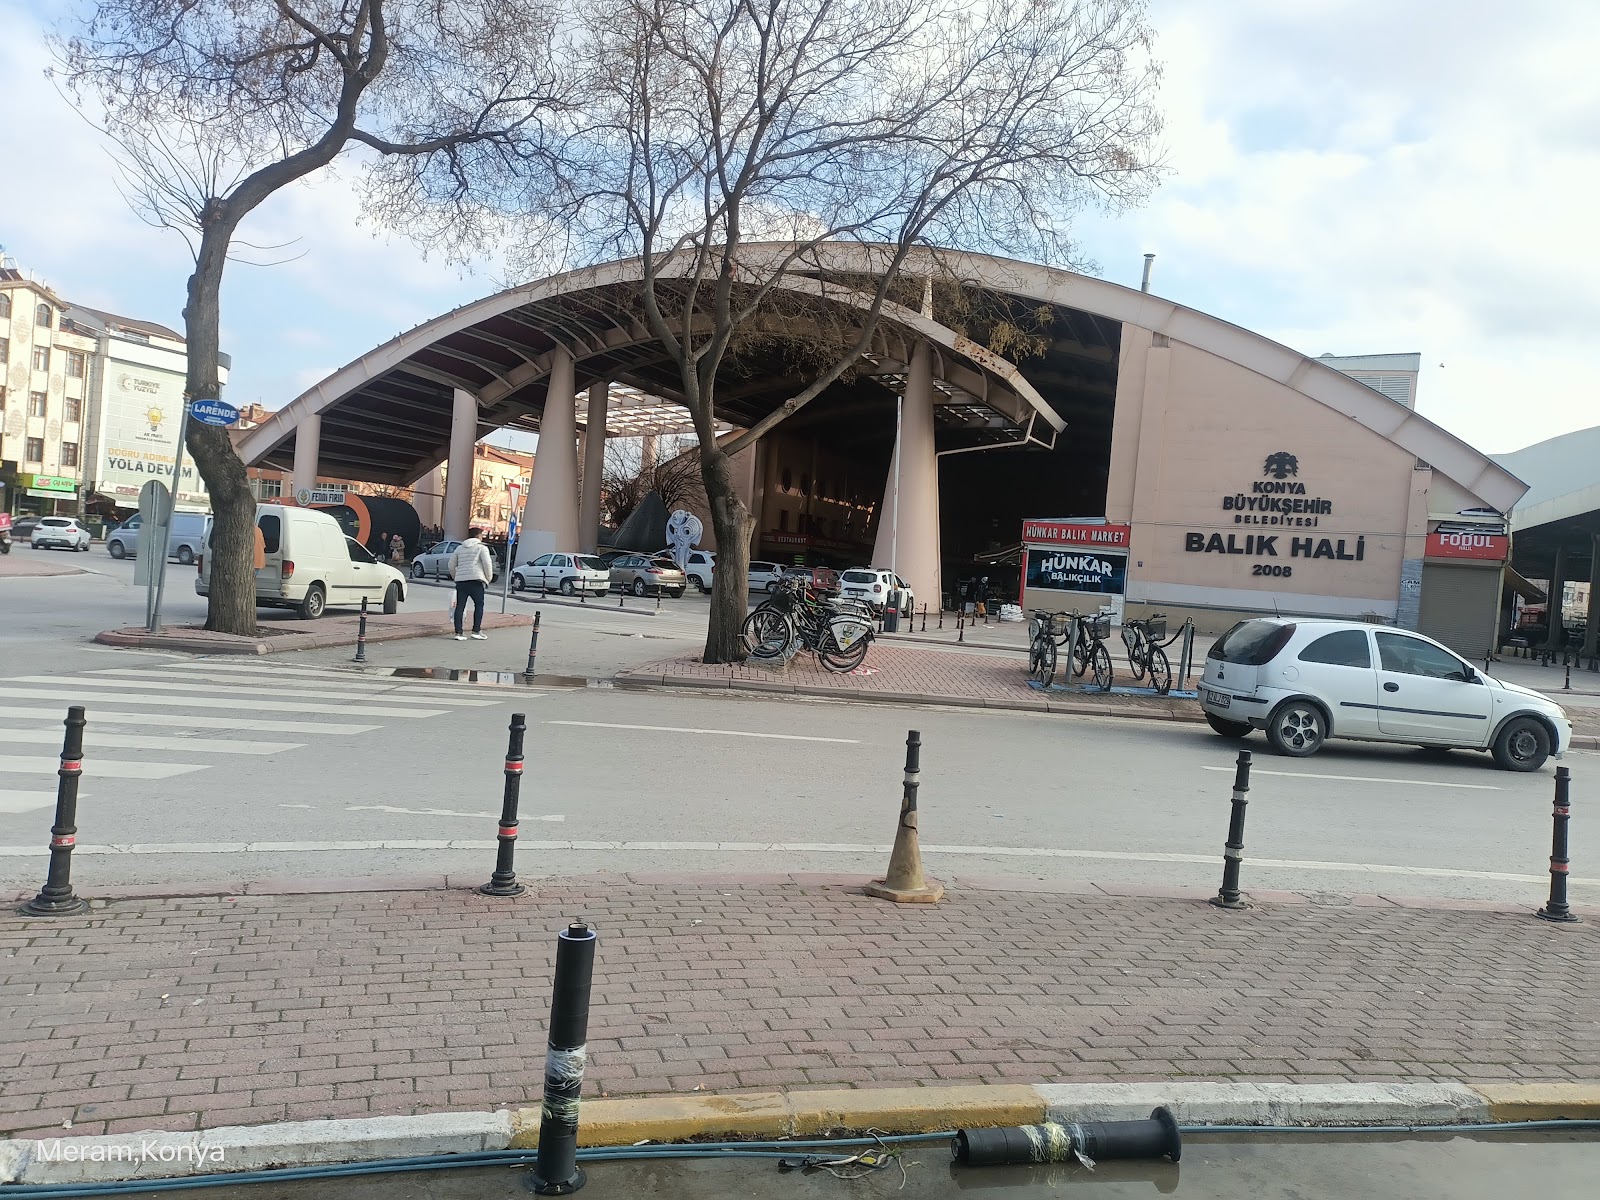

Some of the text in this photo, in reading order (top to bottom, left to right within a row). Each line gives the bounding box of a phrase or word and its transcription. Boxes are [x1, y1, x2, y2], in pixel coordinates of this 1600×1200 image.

[194, 404, 236, 419] LARENDE
[108, 457, 144, 472] YOLA
[1253, 481, 1306, 495] KONYA
[1223, 494, 1332, 515] BÜYÜKŞEHİR
[1235, 514, 1318, 527] BELEDİYESİ
[1026, 524, 1125, 543] HÜNKAR BALIK MARKET
[1440, 533, 1495, 548] FODUL
[1186, 532, 1365, 561] BALIK HALİ
[1041, 553, 1113, 578] HÜNKAR
[1252, 564, 1292, 578] 2008
[1051, 572, 1101, 584] BALIKÇILIK
